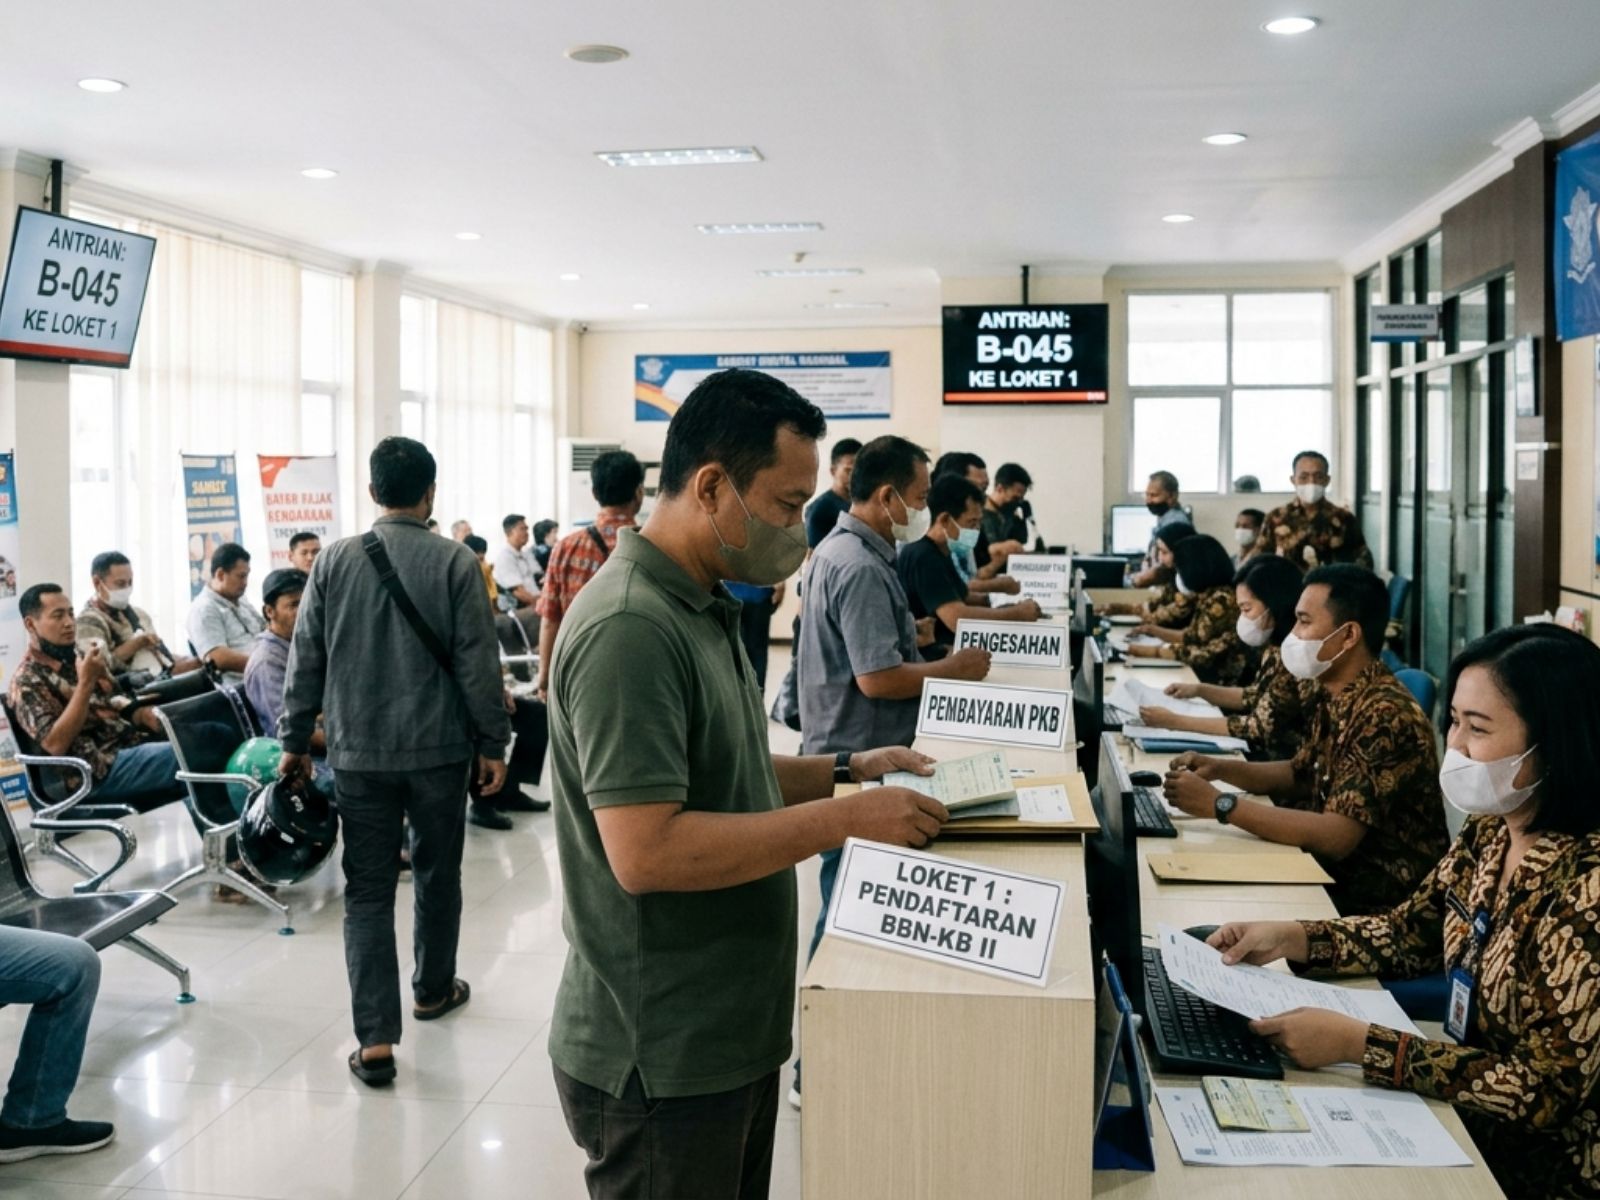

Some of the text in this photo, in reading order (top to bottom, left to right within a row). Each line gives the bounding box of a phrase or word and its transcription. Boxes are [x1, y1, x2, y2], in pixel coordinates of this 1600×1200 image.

[48, 227, 126, 261] ANTRIAN:
[37, 259, 121, 307] B-045
[23, 308, 118, 340] KE LOKET 1
[978, 311, 1070, 329] ANTRIAN:
[977, 334, 1073, 363] B-045
[969, 370, 1077, 387] KE LOKET 1
[961, 631, 1060, 656] PENGESAHAN
[927, 695, 1060, 733] PEMBAYARAN PKB
[896, 861, 977, 897] LOKET
[984, 881, 996, 901] 1
[858, 881, 1036, 939] PENDAFTARAN
[880, 914, 997, 959] BBN-KB II
